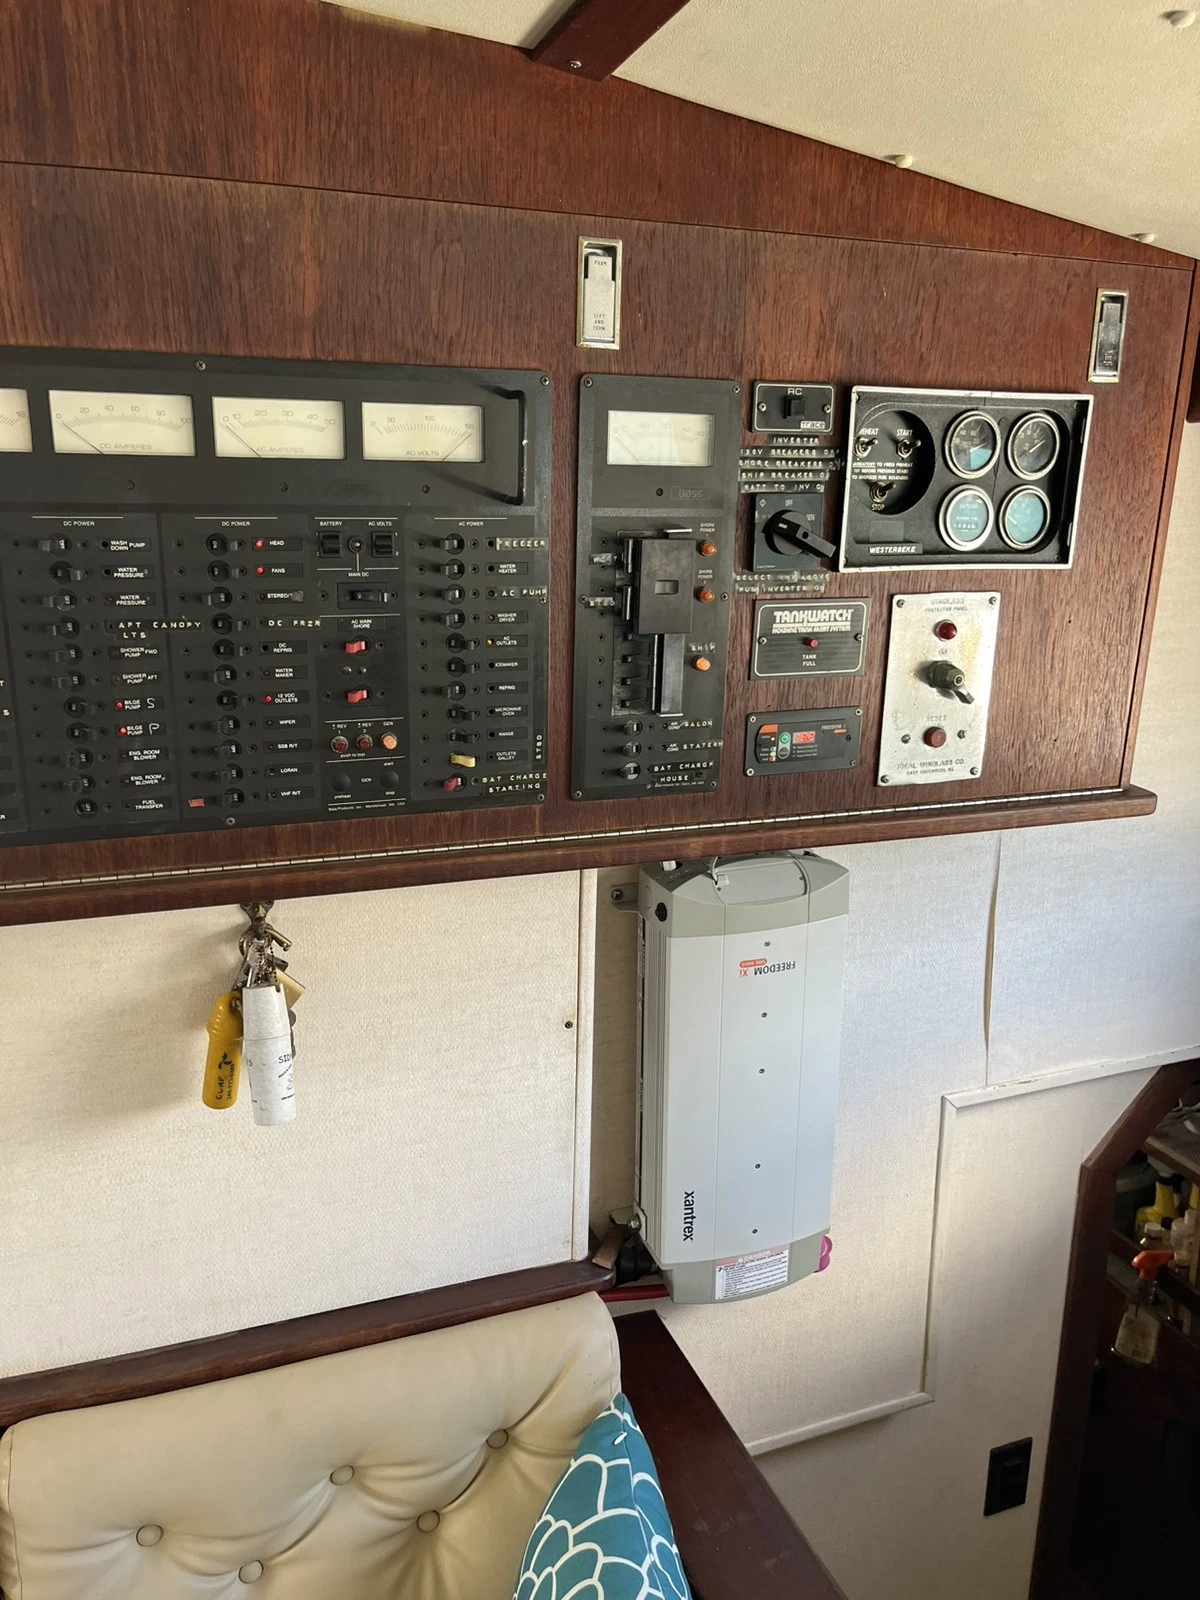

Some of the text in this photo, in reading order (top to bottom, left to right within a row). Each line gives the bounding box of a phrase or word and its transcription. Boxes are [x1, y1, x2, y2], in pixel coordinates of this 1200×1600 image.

[801, 573, 829, 581] ABOVE
[774, 609, 852, 626] TANKWATCH
[146, 697, 156, 709] S
[148, 722, 160, 735] P
[684, 720, 713, 728] SALON
[683, 740, 724, 749] STATERM
[653, 764, 672, 772] BAT
[482, 772, 548, 783] BAT CHARGE
[660, 775, 689, 783] HOUSE
[489, 783, 540, 793] STARTING
[753, 960, 796, 976] FREEDOM
[683, 1190, 697, 1243] xantrex
